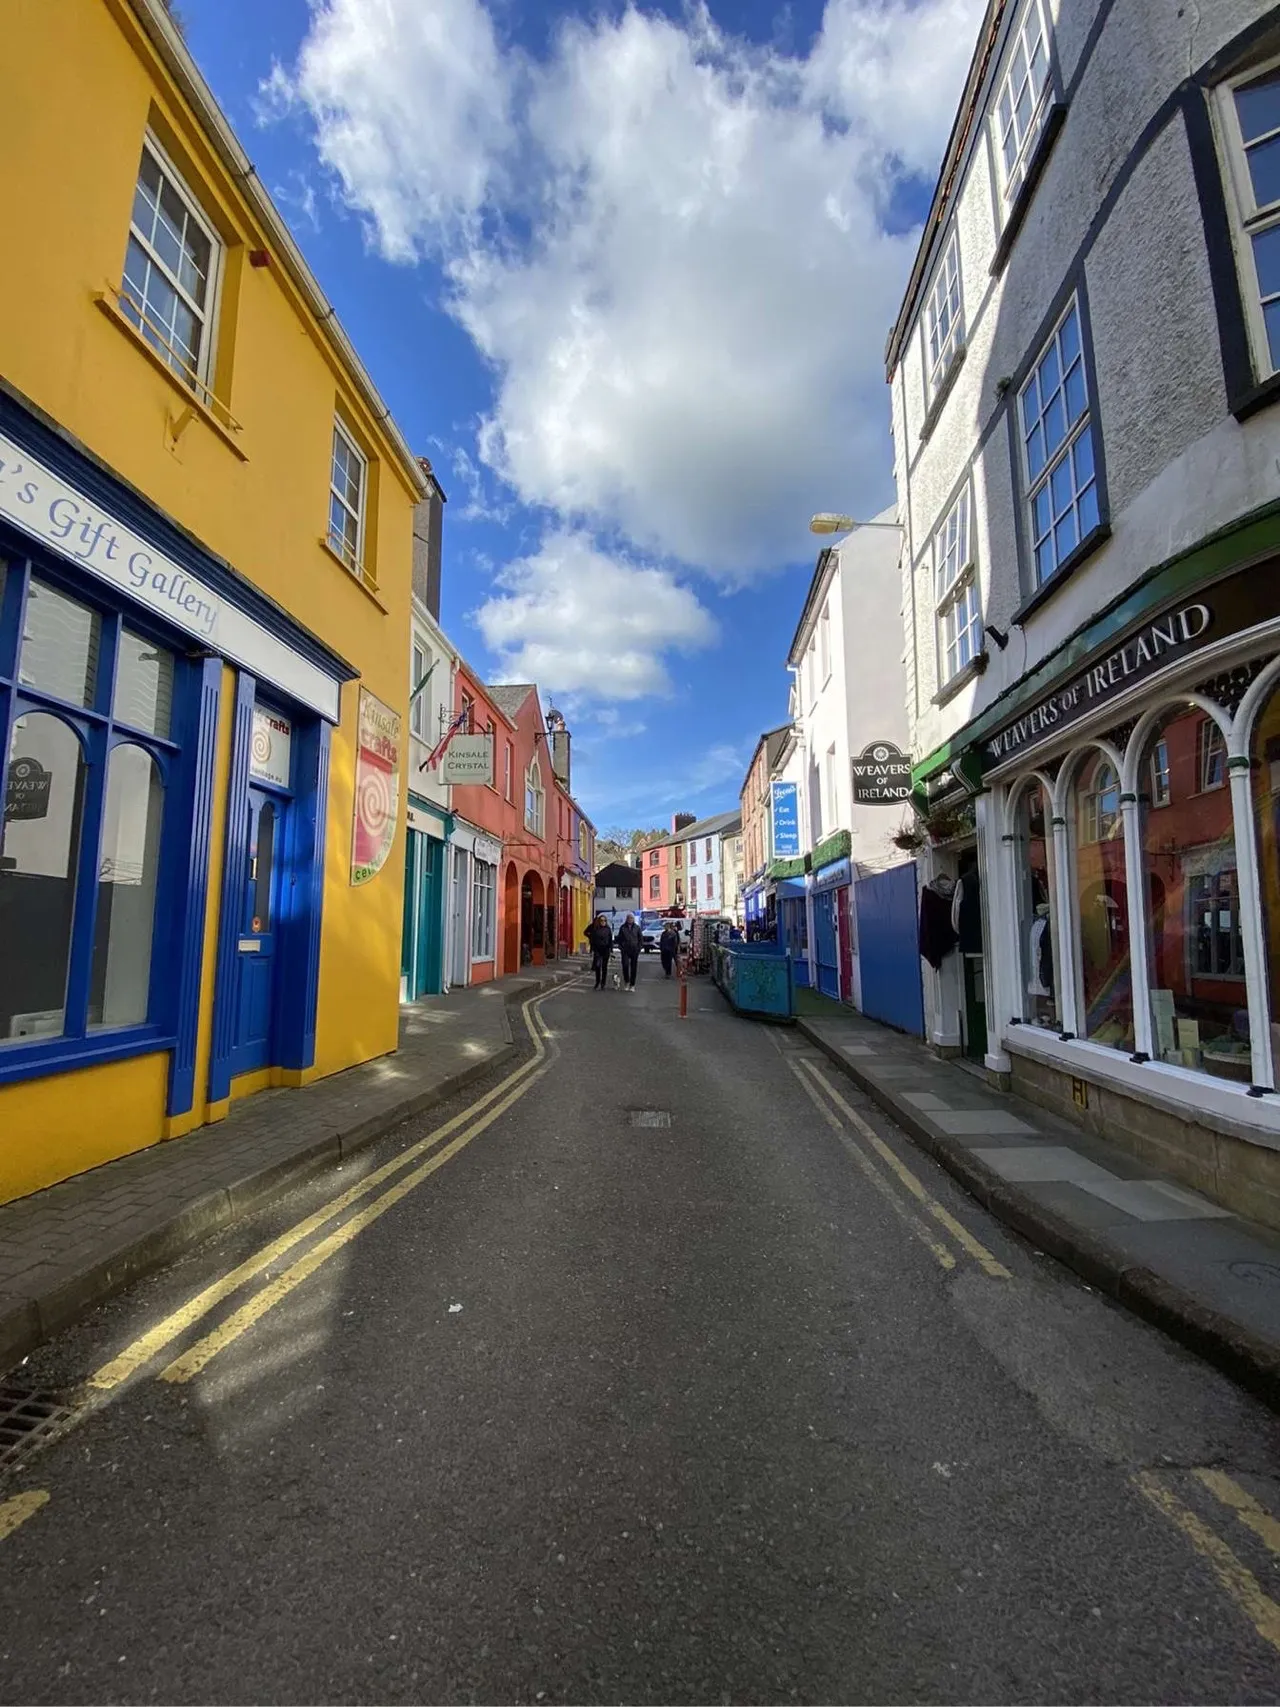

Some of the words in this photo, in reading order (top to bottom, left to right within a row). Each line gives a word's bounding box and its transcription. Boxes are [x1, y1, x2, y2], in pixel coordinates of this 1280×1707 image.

[49, 498, 119, 560] Gift
[128, 552, 217, 635] Gallery
[990, 696, 1058, 758] WEAVERS
[1062, 685, 1080, 711] OF
[1086, 604, 1210, 698] IRELAND
[361, 697, 400, 738] Kinsale
[361, 728, 397, 763] crafts
[448, 750, 489, 759] KINSALE
[447, 761, 490, 770] CRYSTAL
[853, 764, 911, 776] WEAVERS
[876, 777, 889, 785] OF
[858, 787, 909, 799] IRELAND
[780, 832, 798, 840] Sleep
